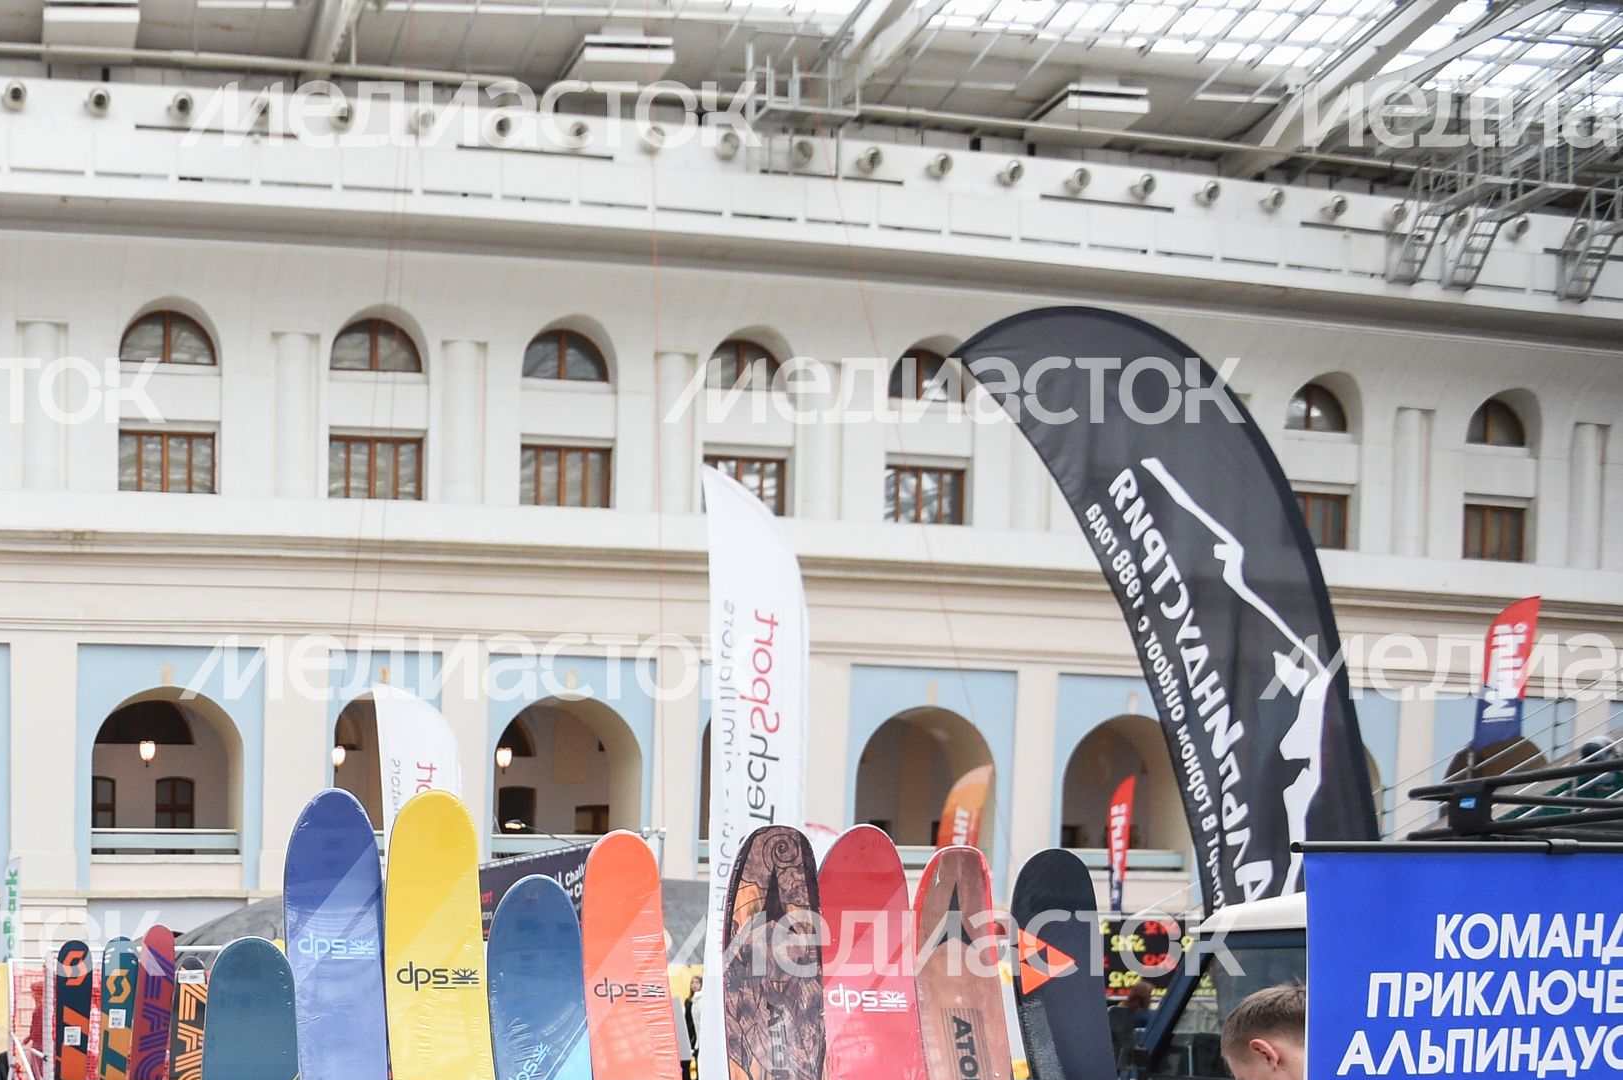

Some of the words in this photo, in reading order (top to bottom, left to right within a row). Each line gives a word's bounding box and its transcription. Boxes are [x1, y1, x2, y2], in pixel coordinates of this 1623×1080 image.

[298, 932, 348, 960] dps
[396, 961, 449, 991] dps
[593, 977, 640, 1004] dps
[827, 983, 878, 1014] dps
